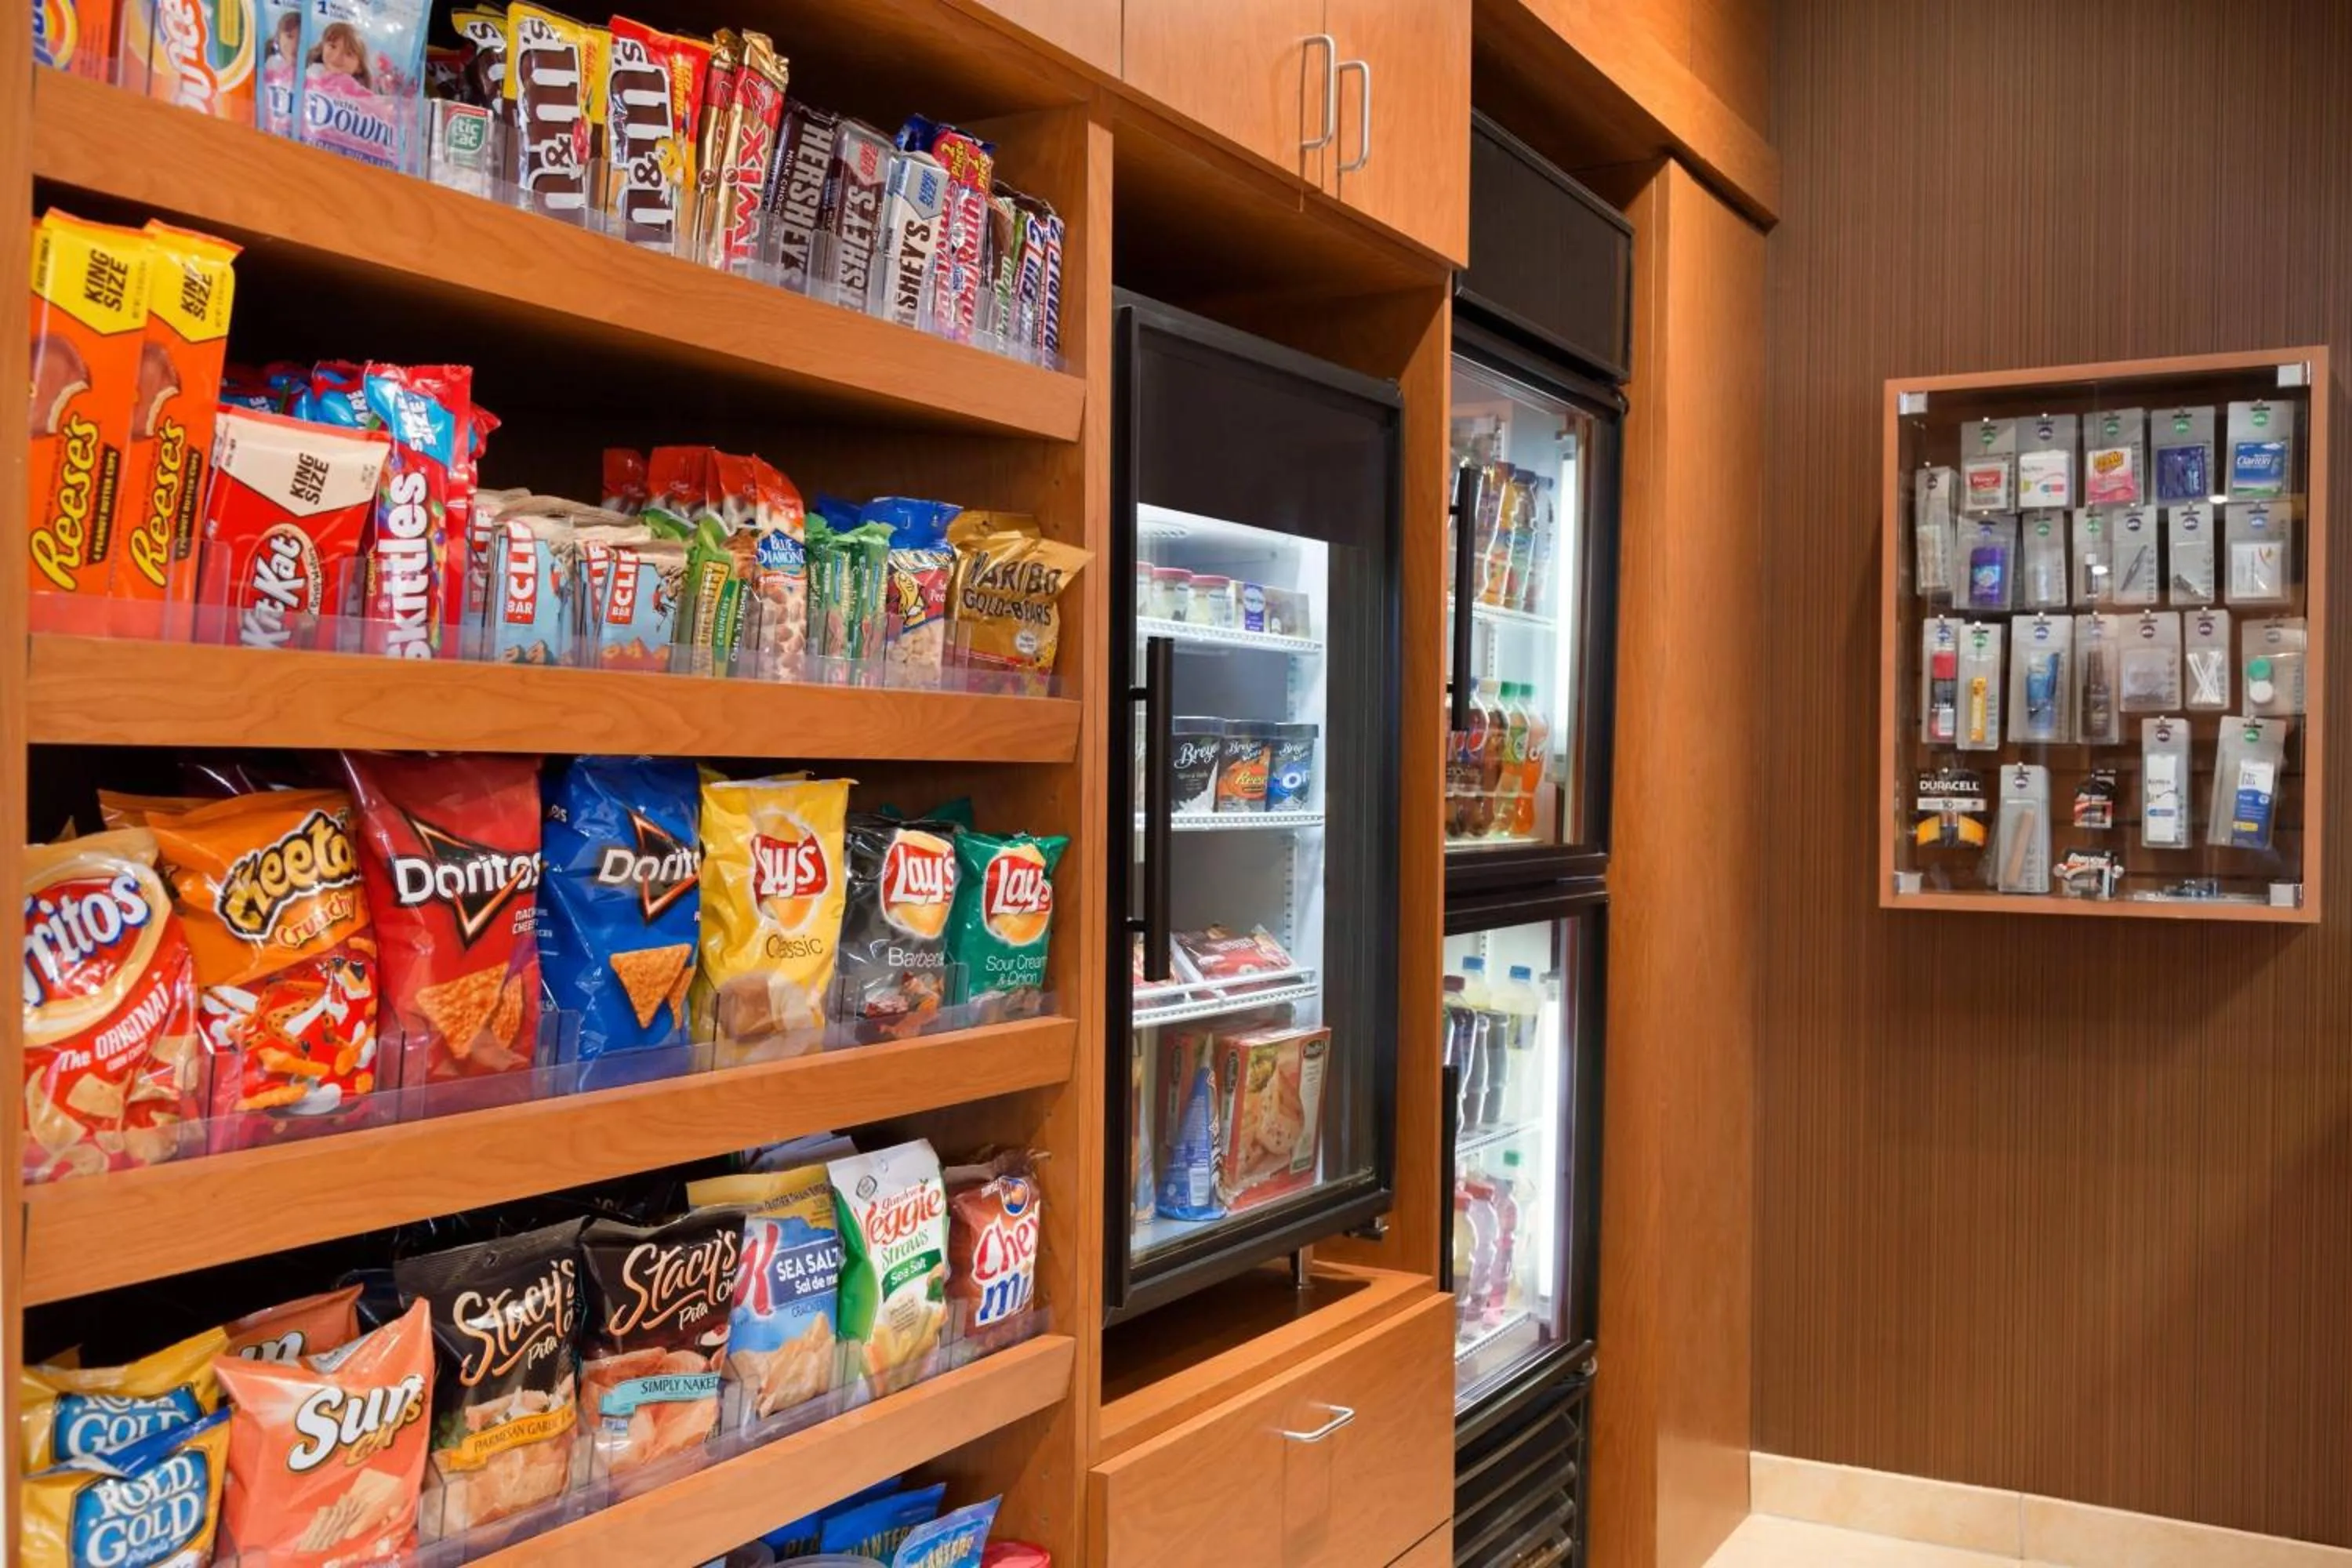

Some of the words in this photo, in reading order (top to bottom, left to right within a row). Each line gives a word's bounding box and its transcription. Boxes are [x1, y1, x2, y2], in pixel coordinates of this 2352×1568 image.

[308, 93, 393, 147] Down
[85, 249, 110, 304] KING
[105, 260, 128, 312] SIZE
[290, 452, 314, 499] KING
[305, 458, 330, 505] SIZE
[759, 548, 806, 564] DIAMON
[508, 602, 532, 615] BAR
[1920, 779, 1980, 792] DURACELL
[597, 842, 700, 884] Dorit
[891, 845, 955, 904] Lay's
[888, 946, 945, 968] Barbec
[985, 954, 1014, 972] Sour
[60, 1049, 92, 1073] The
[855, 1189, 944, 1257] Veggie
[776, 1254, 805, 1283] SEA
[805, 1247, 840, 1273] SALT
[880, 1229, 929, 1271] Straws
[608, 1229, 737, 1336] Stacy's
[890, 1268, 909, 1286] Sea
[909, 1257, 927, 1275] Salt
[453, 1258, 576, 1387] Stacy's
[678, 1302, 709, 1331] Pita
[528, 1335, 558, 1370] Pita
[640, 1377, 681, 1395] SIMPLY
[287, 1374, 425, 1472] Sun
[87, 1491, 200, 1567] GOLD
